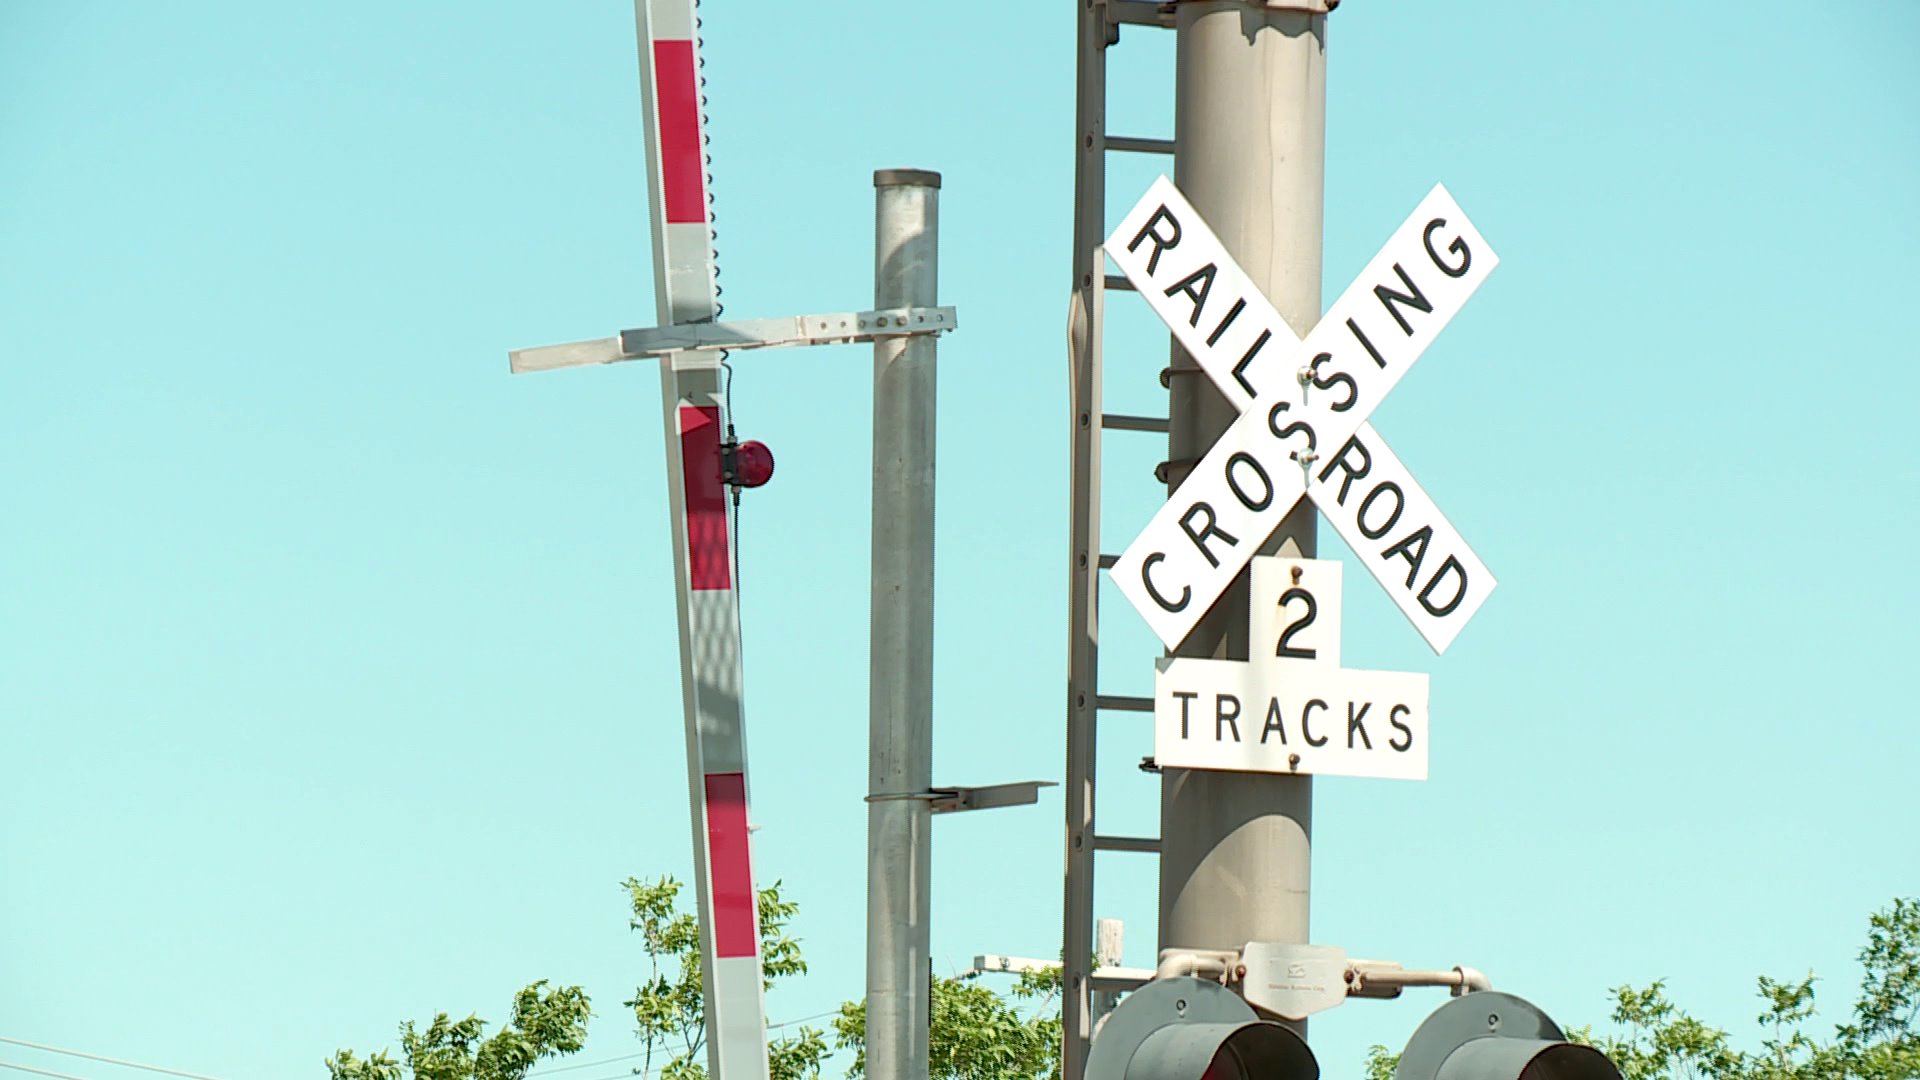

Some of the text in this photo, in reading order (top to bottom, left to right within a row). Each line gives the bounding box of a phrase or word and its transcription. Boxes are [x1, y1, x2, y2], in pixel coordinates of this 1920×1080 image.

[1127, 203, 1468, 617] RAIL ROAD
[1141, 218, 1471, 613] CROSSING
[1173, 690, 1412, 752] TRACKS
[1275, 587, 1317, 660] 2
